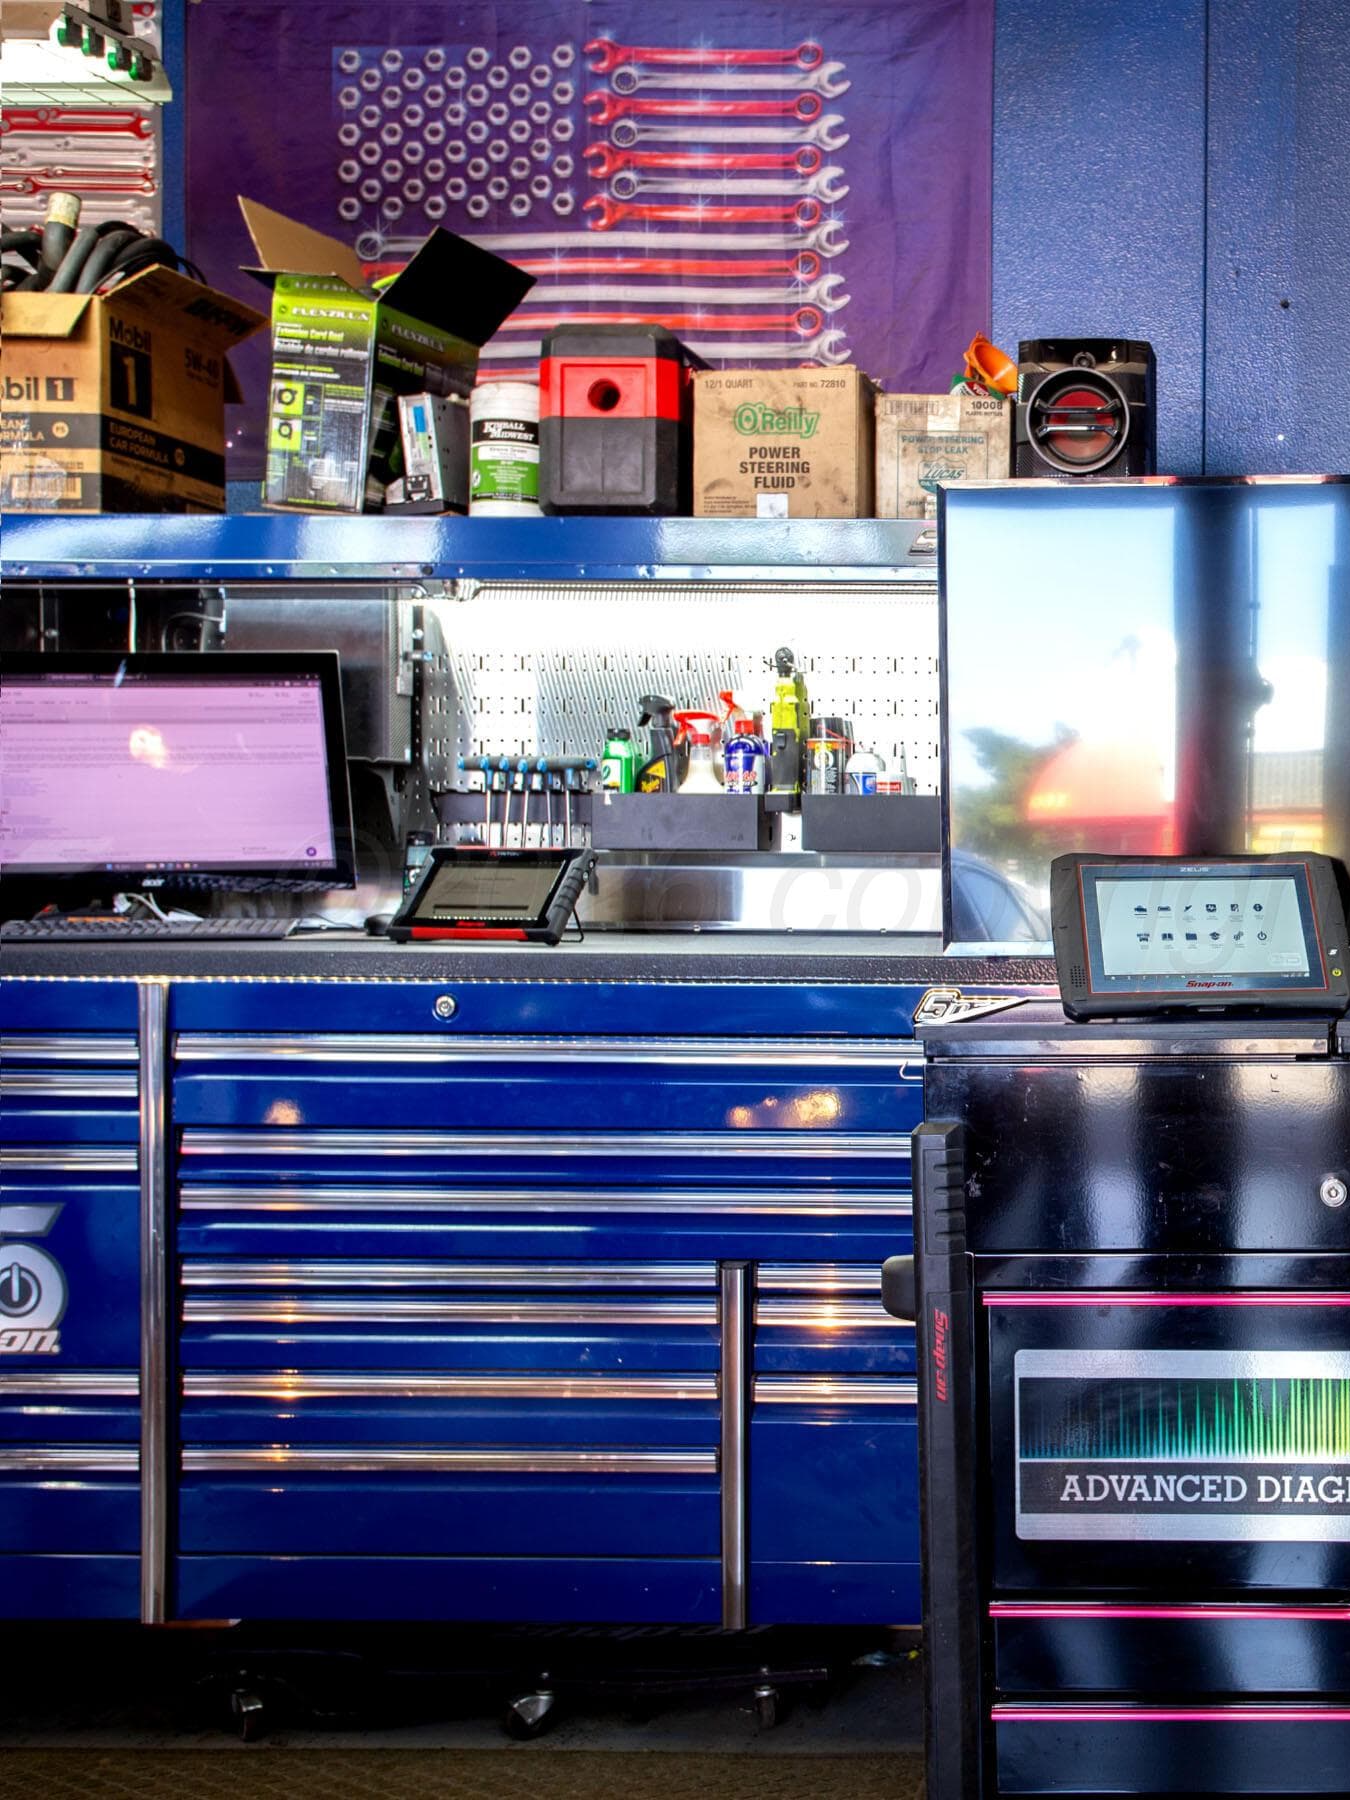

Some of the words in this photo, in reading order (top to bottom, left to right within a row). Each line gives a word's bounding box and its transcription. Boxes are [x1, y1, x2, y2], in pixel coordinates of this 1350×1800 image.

[292, 306, 369, 321] FLEXZILLA
[109, 317, 152, 352] Mobil
[391, 325, 444, 353] FLEXZILLA
[122, 356, 137, 406] 1
[704, 379, 722, 389] 12/1
[725, 379, 753, 388] QUART
[820, 379, 846, 389] 72810
[0, 376, 39, 401] bil
[483, 421, 525, 433] KIMBALL
[735, 404, 818, 438] O'Reilly
[110, 421, 156, 446] EUROPEAN
[490, 428, 535, 441] MIDWEST
[901, 435, 933, 444] POWER
[938, 436, 984, 445] STEERING
[110, 437, 128, 452] CAR
[130, 441, 169, 464] FORMULA
[749, 446, 801, 459] POWER
[739, 461, 811, 474] STEERING
[923, 469, 965, 479] LUCAS
[754, 476, 796, 489] FLUID
[1185, 980, 1234, 989] Snap-on
[933, 1307, 949, 1402] Snap-on
[1060, 1474, 1248, 1503] ADVANCED
